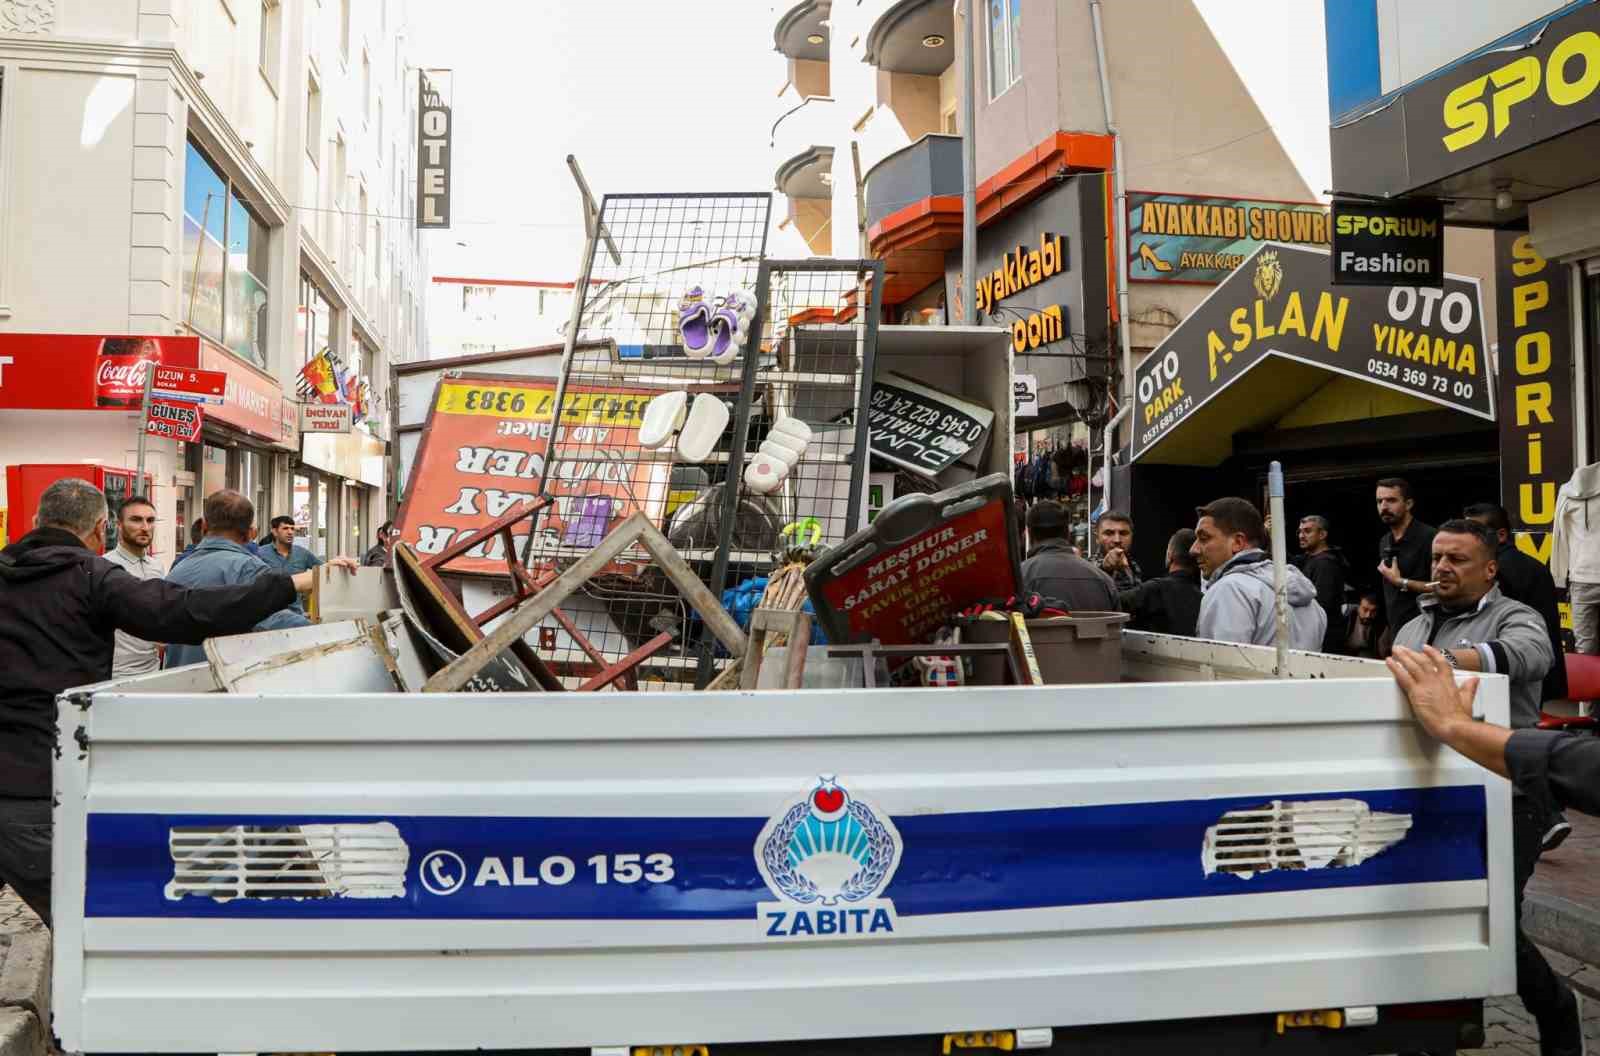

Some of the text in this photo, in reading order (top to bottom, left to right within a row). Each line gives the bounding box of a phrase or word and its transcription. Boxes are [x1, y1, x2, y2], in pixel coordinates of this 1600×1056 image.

[423, 110, 447, 224] OTEL
[1142, 202, 1244, 238] AYAKKABI
[1340, 251, 1430, 274] Fashion
[1011, 303, 1064, 353] oom
[1387, 286, 1473, 334] OTO
[1206, 291, 1349, 381] ASLAN
[1373, 323, 1477, 376] YIKAMA
[157, 370, 184, 382] UZUN
[1138, 351, 1179, 403] OTO
[1367, 358, 1474, 400] 0534 369 73 00
[464, 388, 526, 413] 9383
[889, 396, 914, 416] 24
[909, 404, 941, 426] 822
[1145, 377, 1184, 425] PARK
[936, 414, 969, 437] 545
[966, 424, 982, 442] 0
[843, 528, 989, 609] SARAY DÖNER
[473, 853, 676, 887] ALO 153
[765, 908, 894, 937] ZABITA
